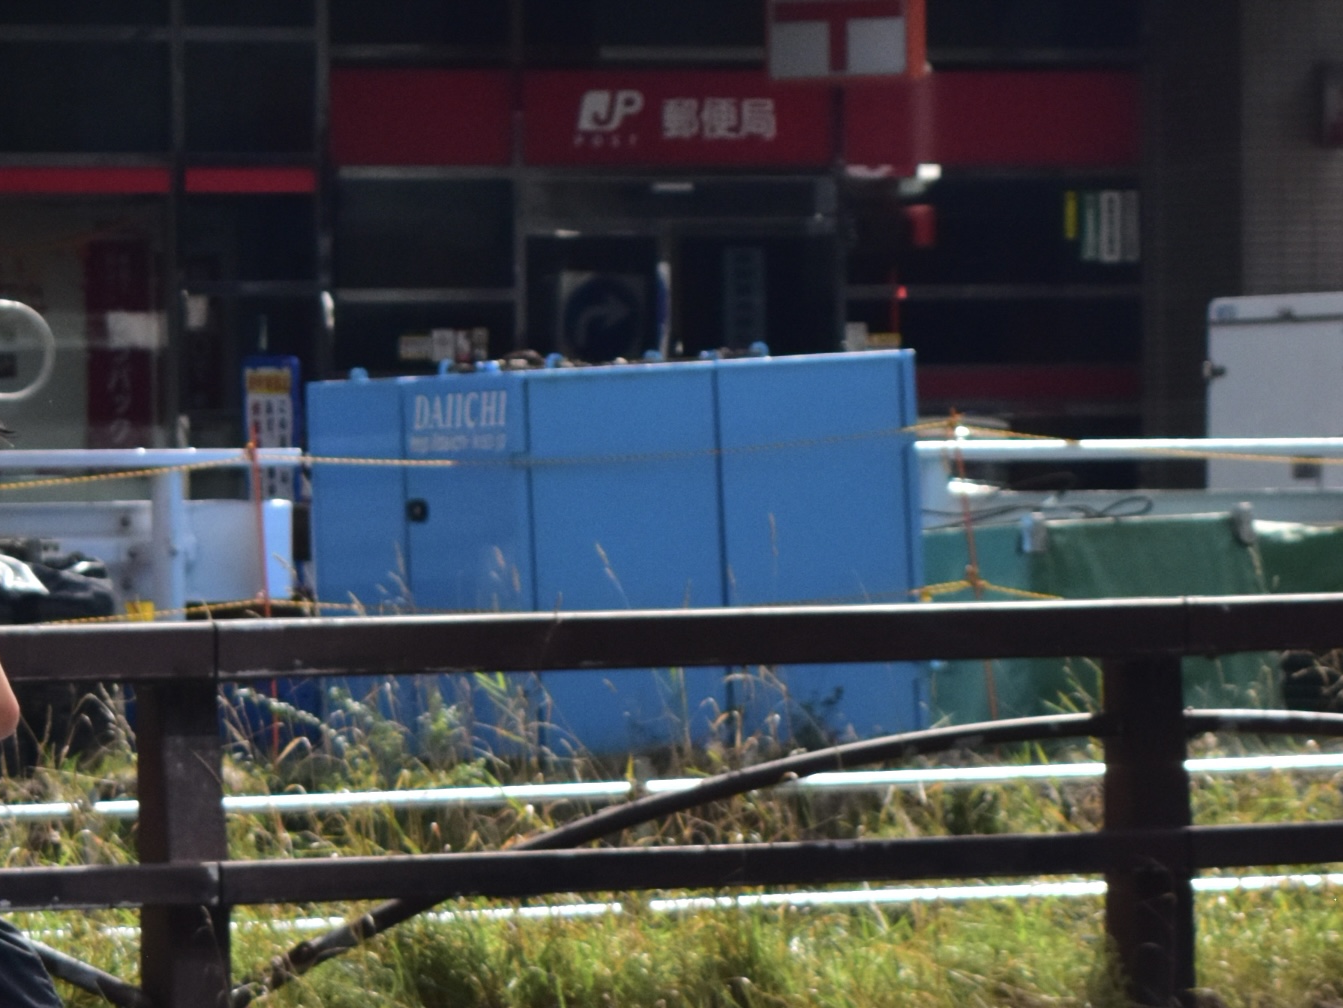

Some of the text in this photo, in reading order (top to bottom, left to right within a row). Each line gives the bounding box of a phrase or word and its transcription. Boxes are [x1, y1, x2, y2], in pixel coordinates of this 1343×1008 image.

[577, 89, 777, 141] JP 郵便局
[413, 390, 508, 430] DAIICHI
